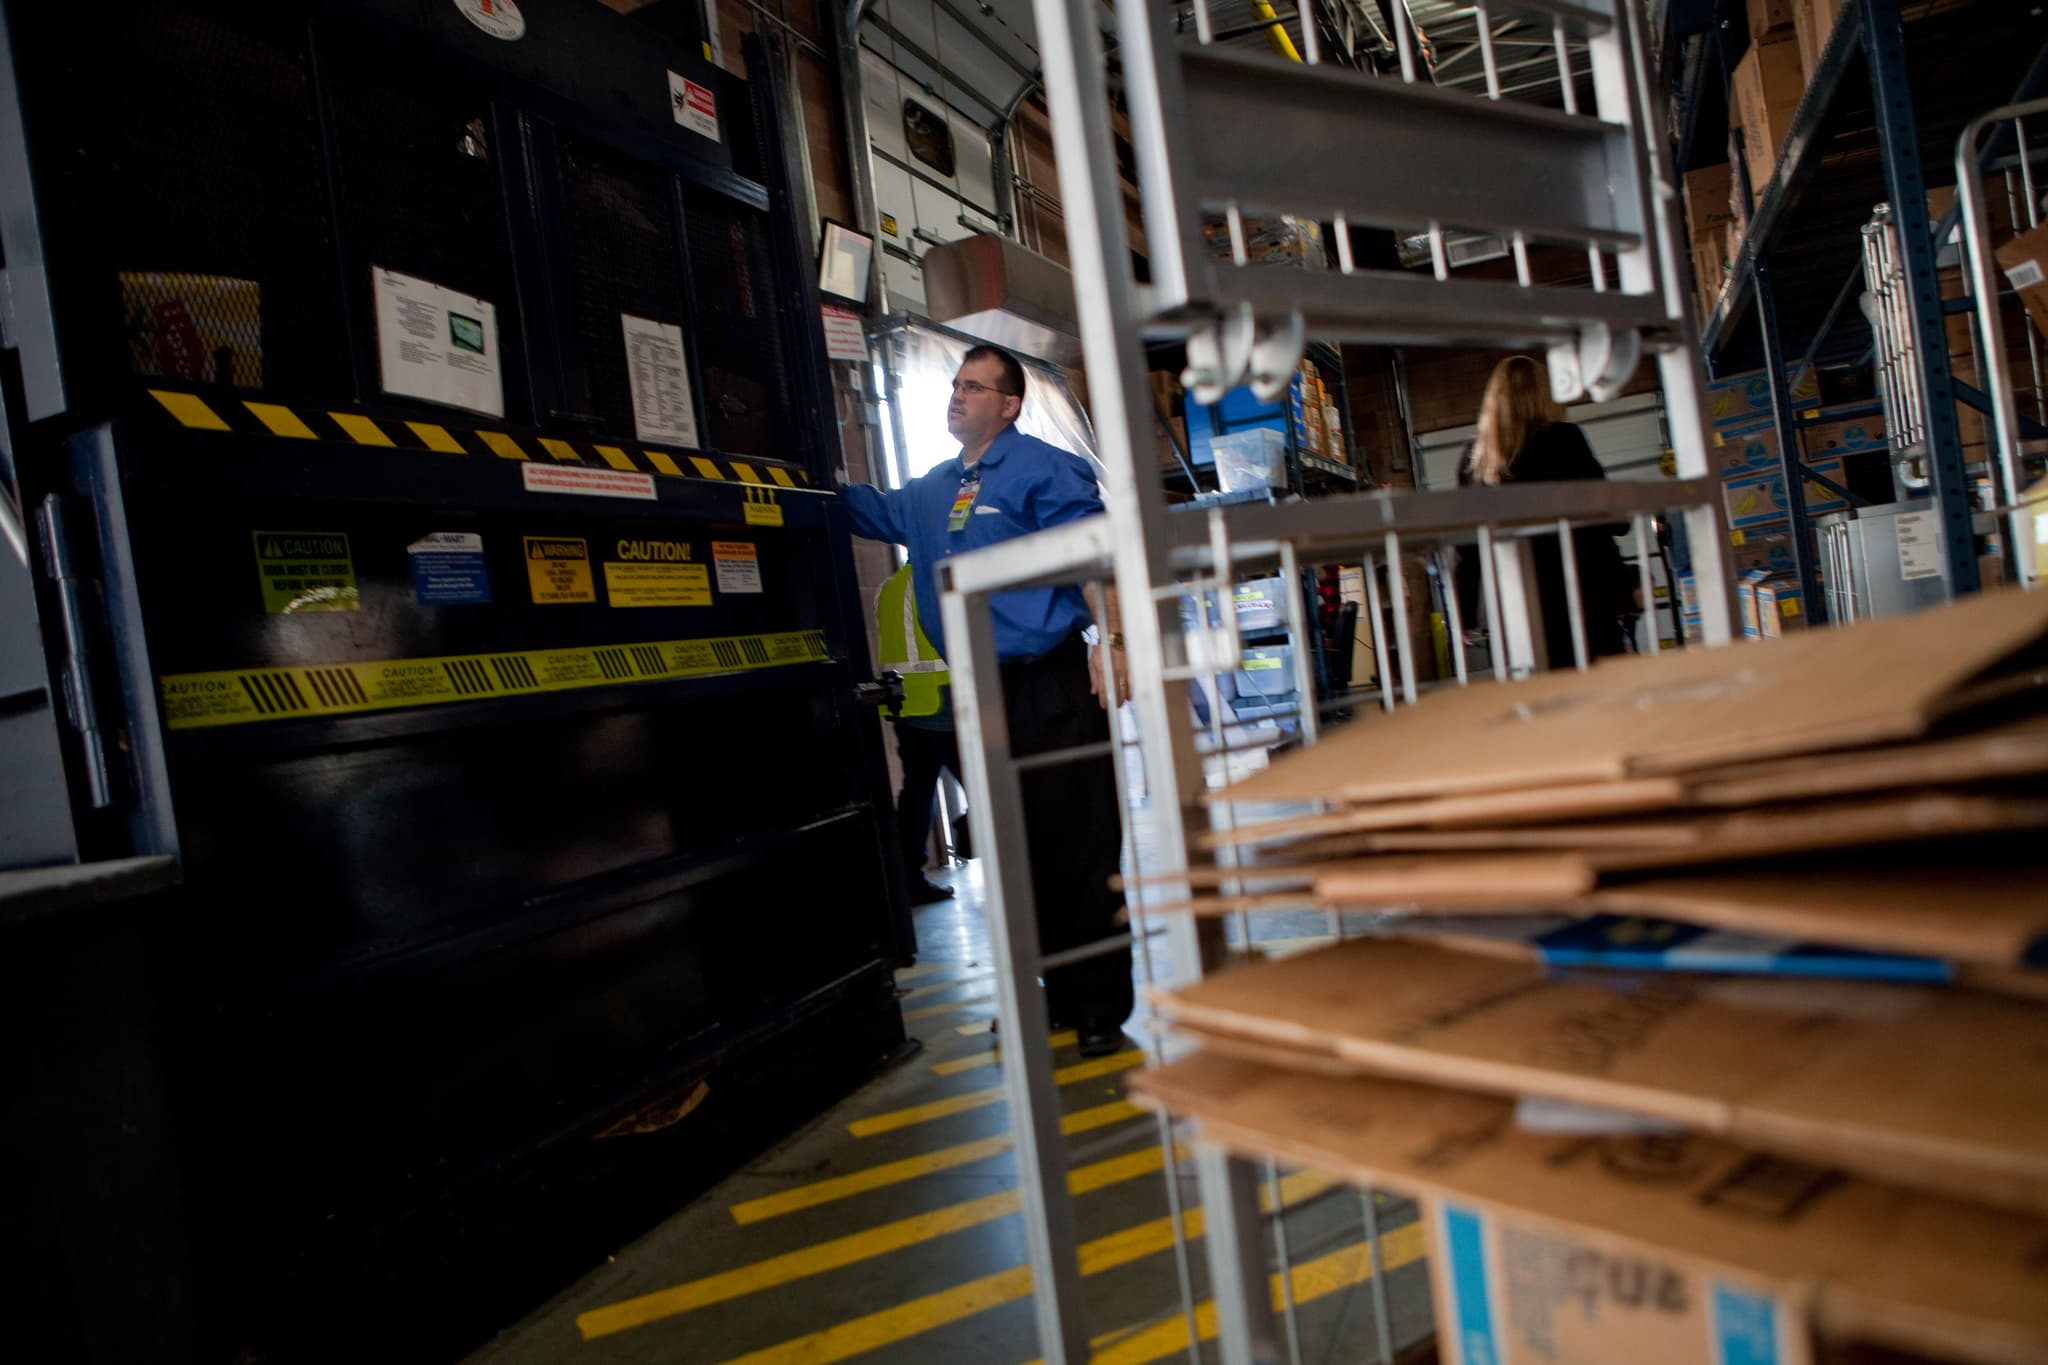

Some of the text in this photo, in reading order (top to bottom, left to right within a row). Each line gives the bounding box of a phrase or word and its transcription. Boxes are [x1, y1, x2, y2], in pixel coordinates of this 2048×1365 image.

[283, 538, 344, 555] CAUTION
[543, 543, 585, 558] WARNING
[617, 540, 691, 561] CAUTION!
[382, 664, 437, 678] CAUTION!
